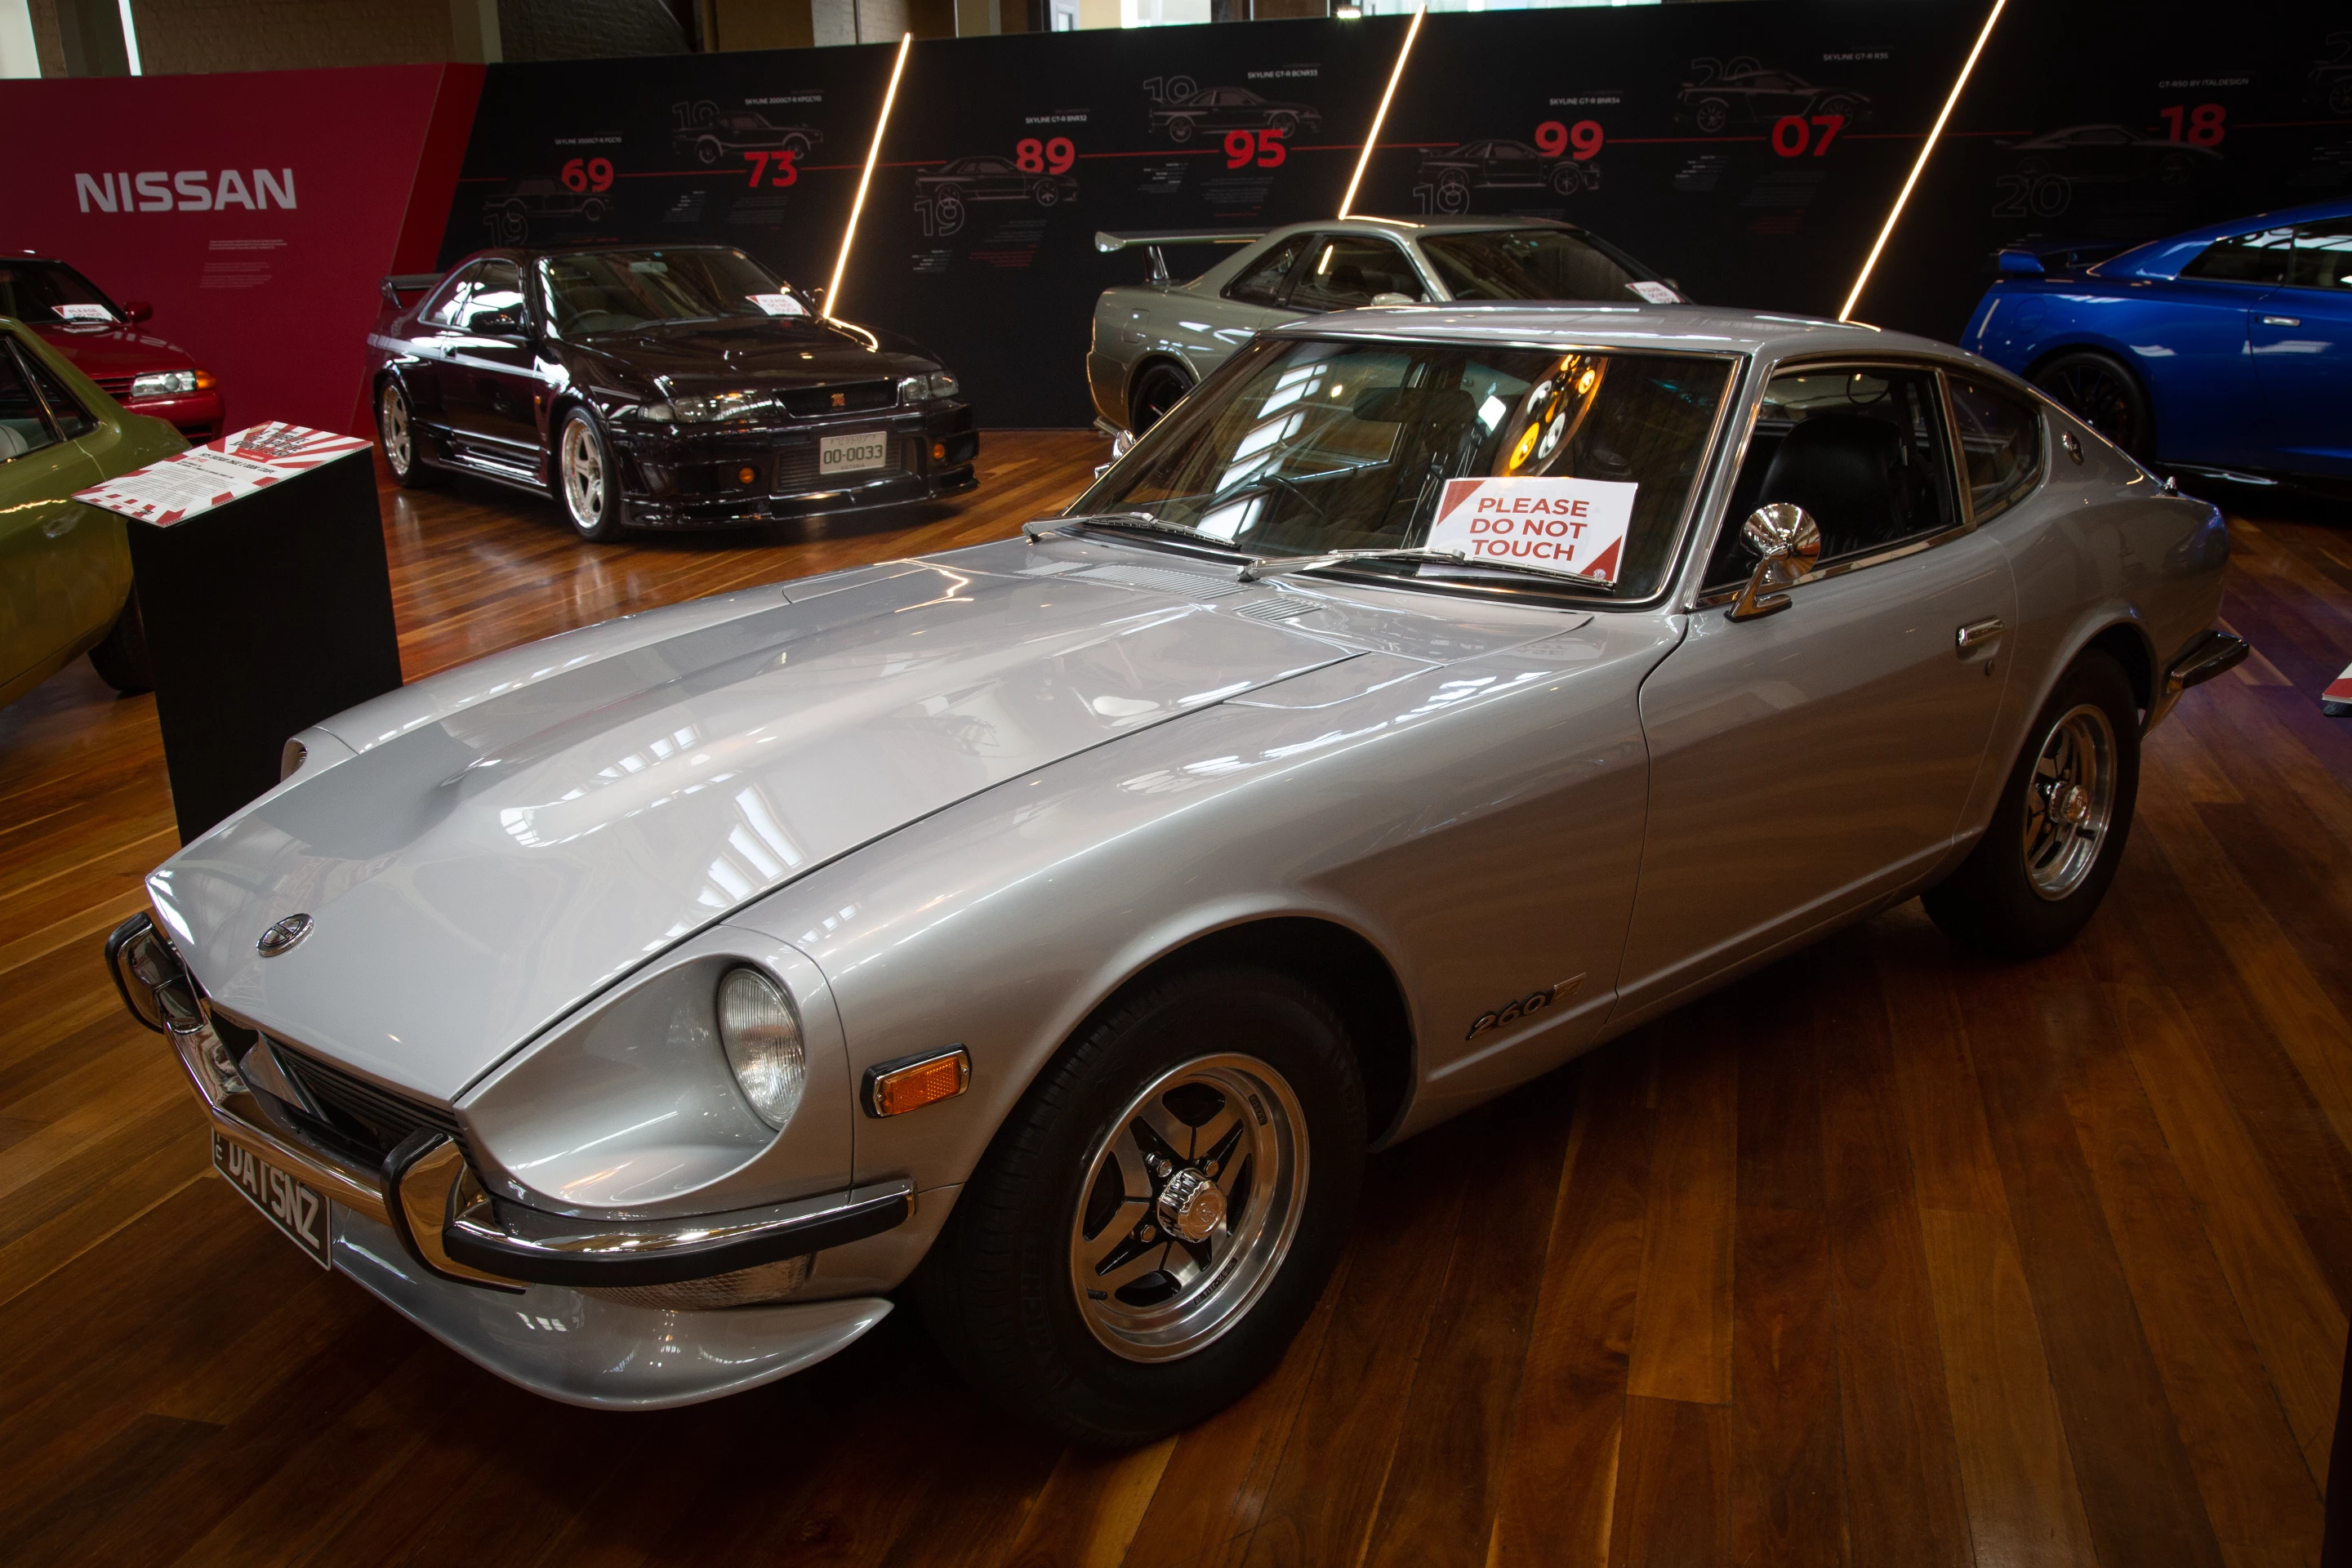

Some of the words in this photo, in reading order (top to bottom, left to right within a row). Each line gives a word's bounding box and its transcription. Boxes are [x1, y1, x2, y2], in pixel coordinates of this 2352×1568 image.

[1247, 71, 1274, 79] SKYLINE
[2202, 78, 2249, 87] ITALDESIGN
[1549, 98, 1578, 106] SKYLINE
[1026, 116, 1050, 124] SKYLINE
[1771, 114, 1846, 157] 07
[2159, 103, 2227, 147] 18
[1016, 136, 1076, 175] 89
[1223, 129, 1286, 169] 95
[1535, 119, 1604, 160] 99
[561, 157, 614, 192] 69
[744, 150, 797, 188] 73
[74, 168, 297, 213] NISSAN
[823, 444, 883, 464] 00-0033
[1477, 497, 1590, 518] PLEASE
[1469, 518, 1515, 534] DO
[1522, 519, 1588, 539] NOT
[1471, 539, 1575, 561] TOUCH
[229, 1142, 320, 1250] DATSNZ
